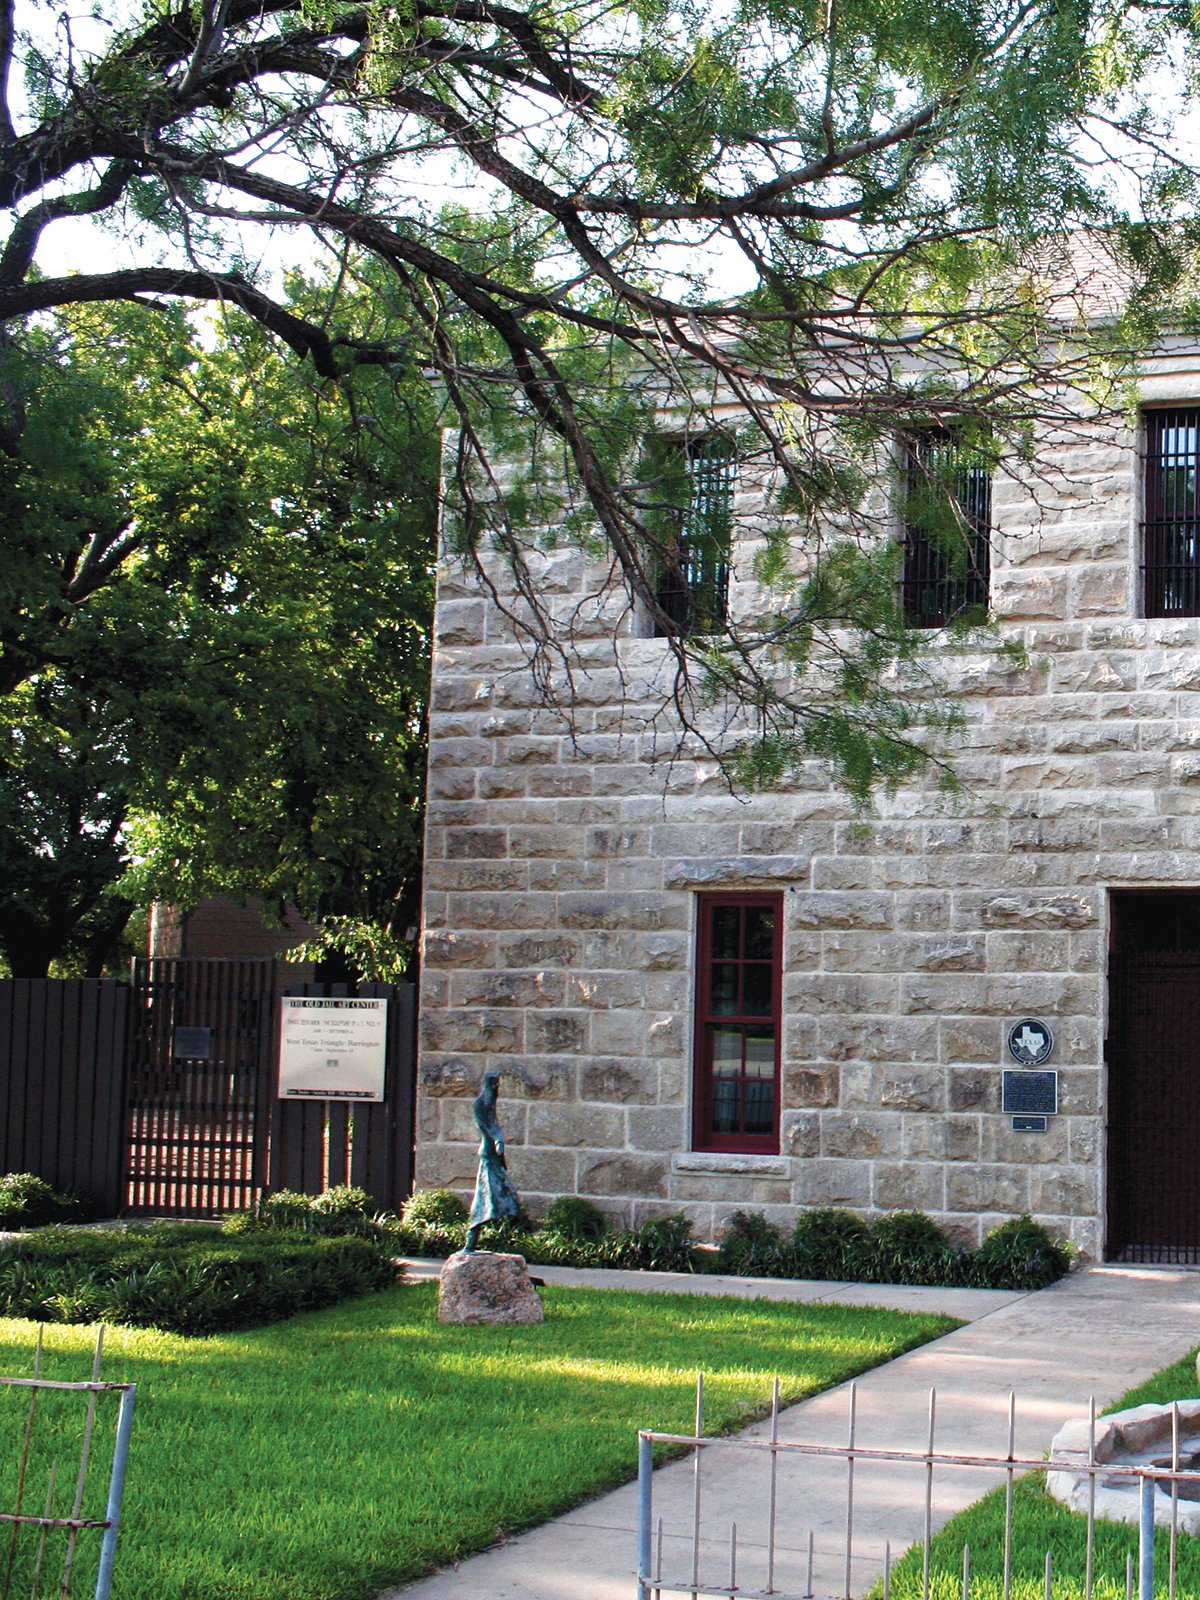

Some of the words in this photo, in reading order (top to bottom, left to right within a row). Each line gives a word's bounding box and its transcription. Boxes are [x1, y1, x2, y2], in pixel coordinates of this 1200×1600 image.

[290, 1000, 304, 1008] THE
[305, 1000, 321, 1008] OLD
[338, 1001, 350, 1009] ART
[352, 1001, 379, 1009] CENTER
[302, 1039, 319, 1047] Texas
